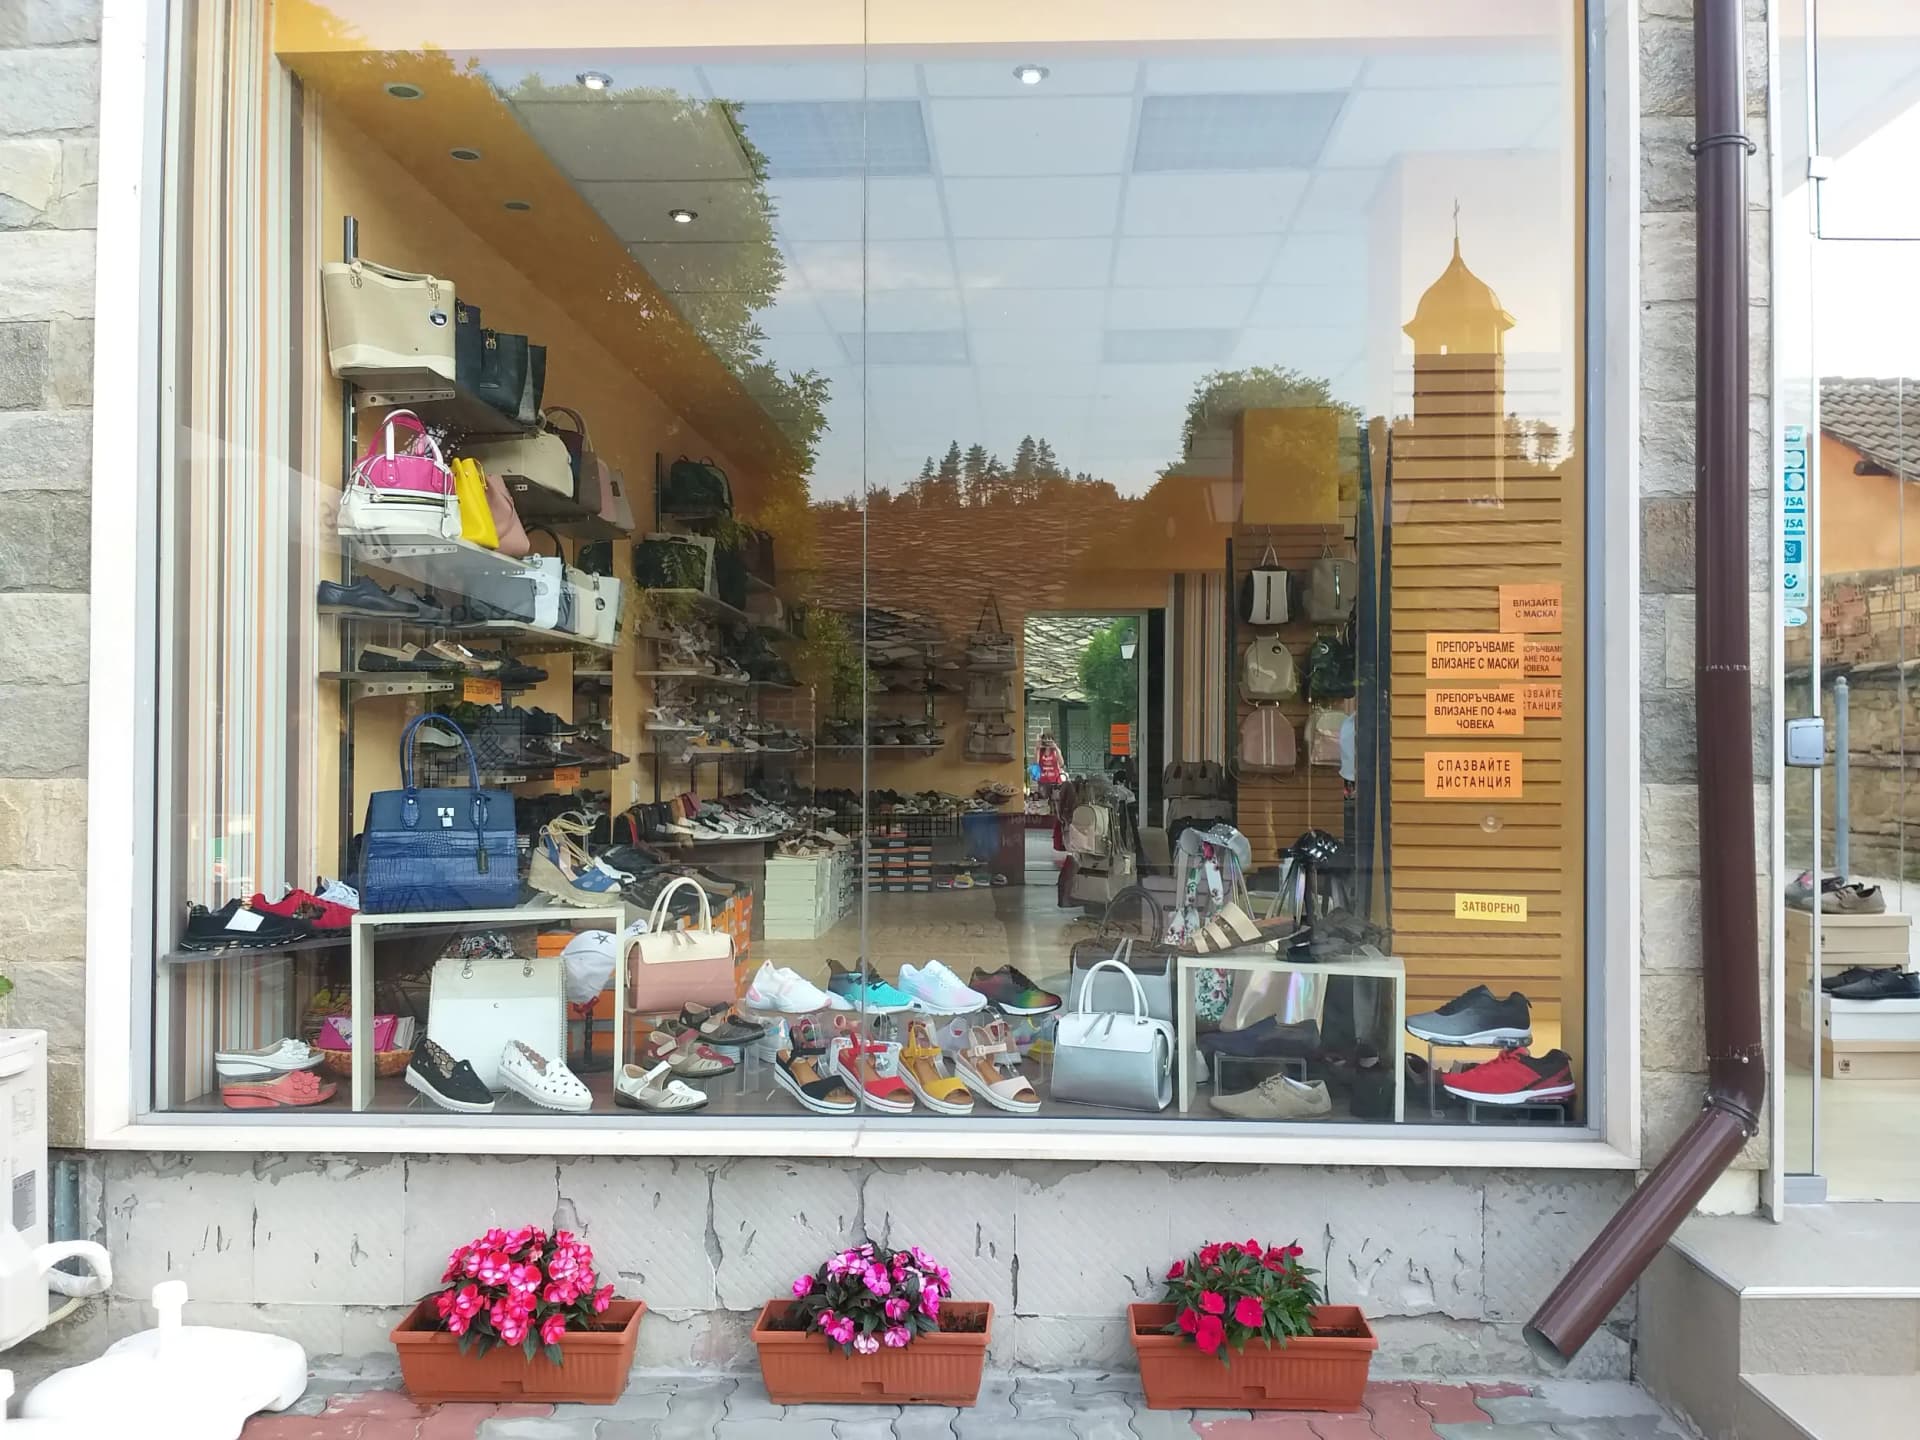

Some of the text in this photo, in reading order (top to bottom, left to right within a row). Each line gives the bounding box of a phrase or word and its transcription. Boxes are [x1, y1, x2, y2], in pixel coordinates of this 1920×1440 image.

[1784, 496, 1803, 506] ISA
[1784, 519, 1803, 528] ISA
[1513, 598, 1558, 607] ВЛИЗАЙТЕ
[1436, 641, 1515, 653] ПРЕПОРЪЧВАМЕ
[1432, 657, 1519, 669] ВЛИЗАНЕ С МАСКИ
[1436, 693, 1515, 703] ПРЕПОРЪЧВАМЕ
[1434, 706, 1516, 716] ВЛИЗАНЕ ПО 4-ма
[1456, 719, 1494, 729] ЧОВЕКА
[1437, 757, 1510, 771] СПАЗВАЙТЕ
[1437, 776, 1511, 790] ДИСТАНЦИЯ
[1462, 901, 1520, 914] ЗАТВОРЕНО
